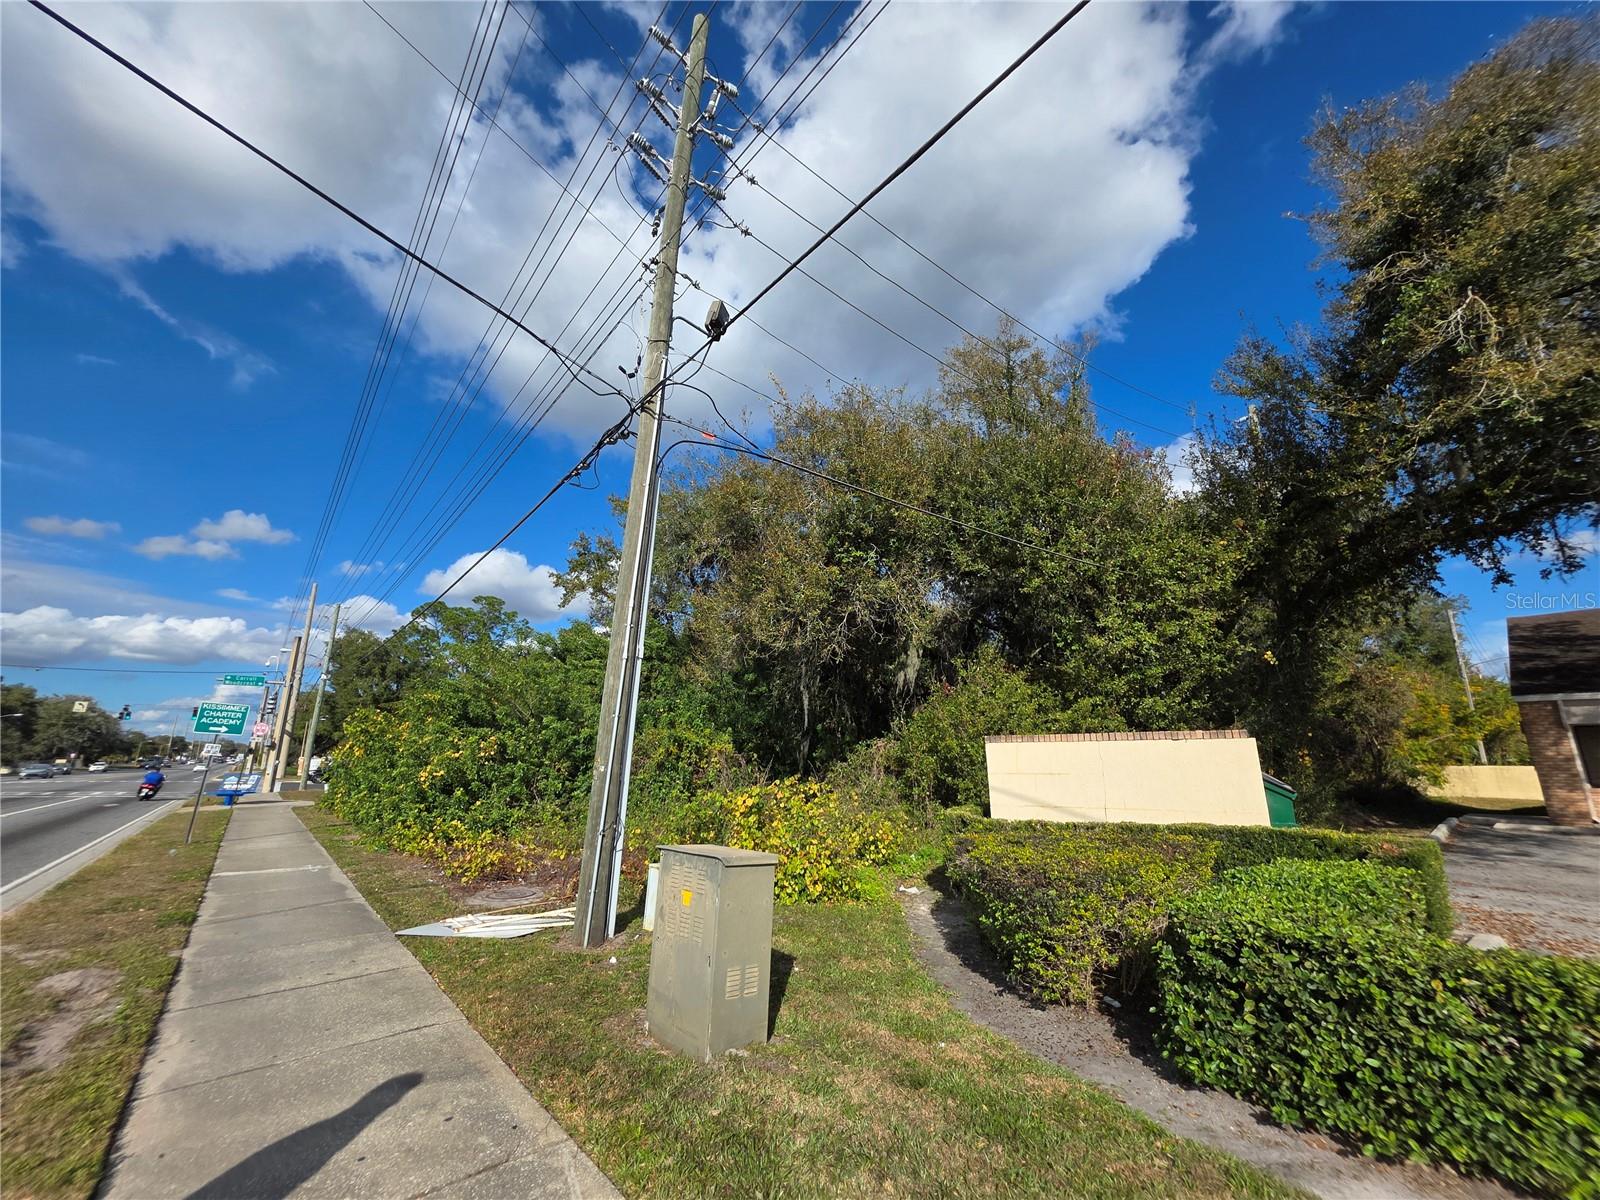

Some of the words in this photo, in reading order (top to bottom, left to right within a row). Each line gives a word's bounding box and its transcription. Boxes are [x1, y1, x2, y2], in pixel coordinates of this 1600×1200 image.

[203, 703, 247, 712] KISSIMMEE
[204, 710, 243, 719] CHARTER
[200, 717, 242, 725] ACADEMY
